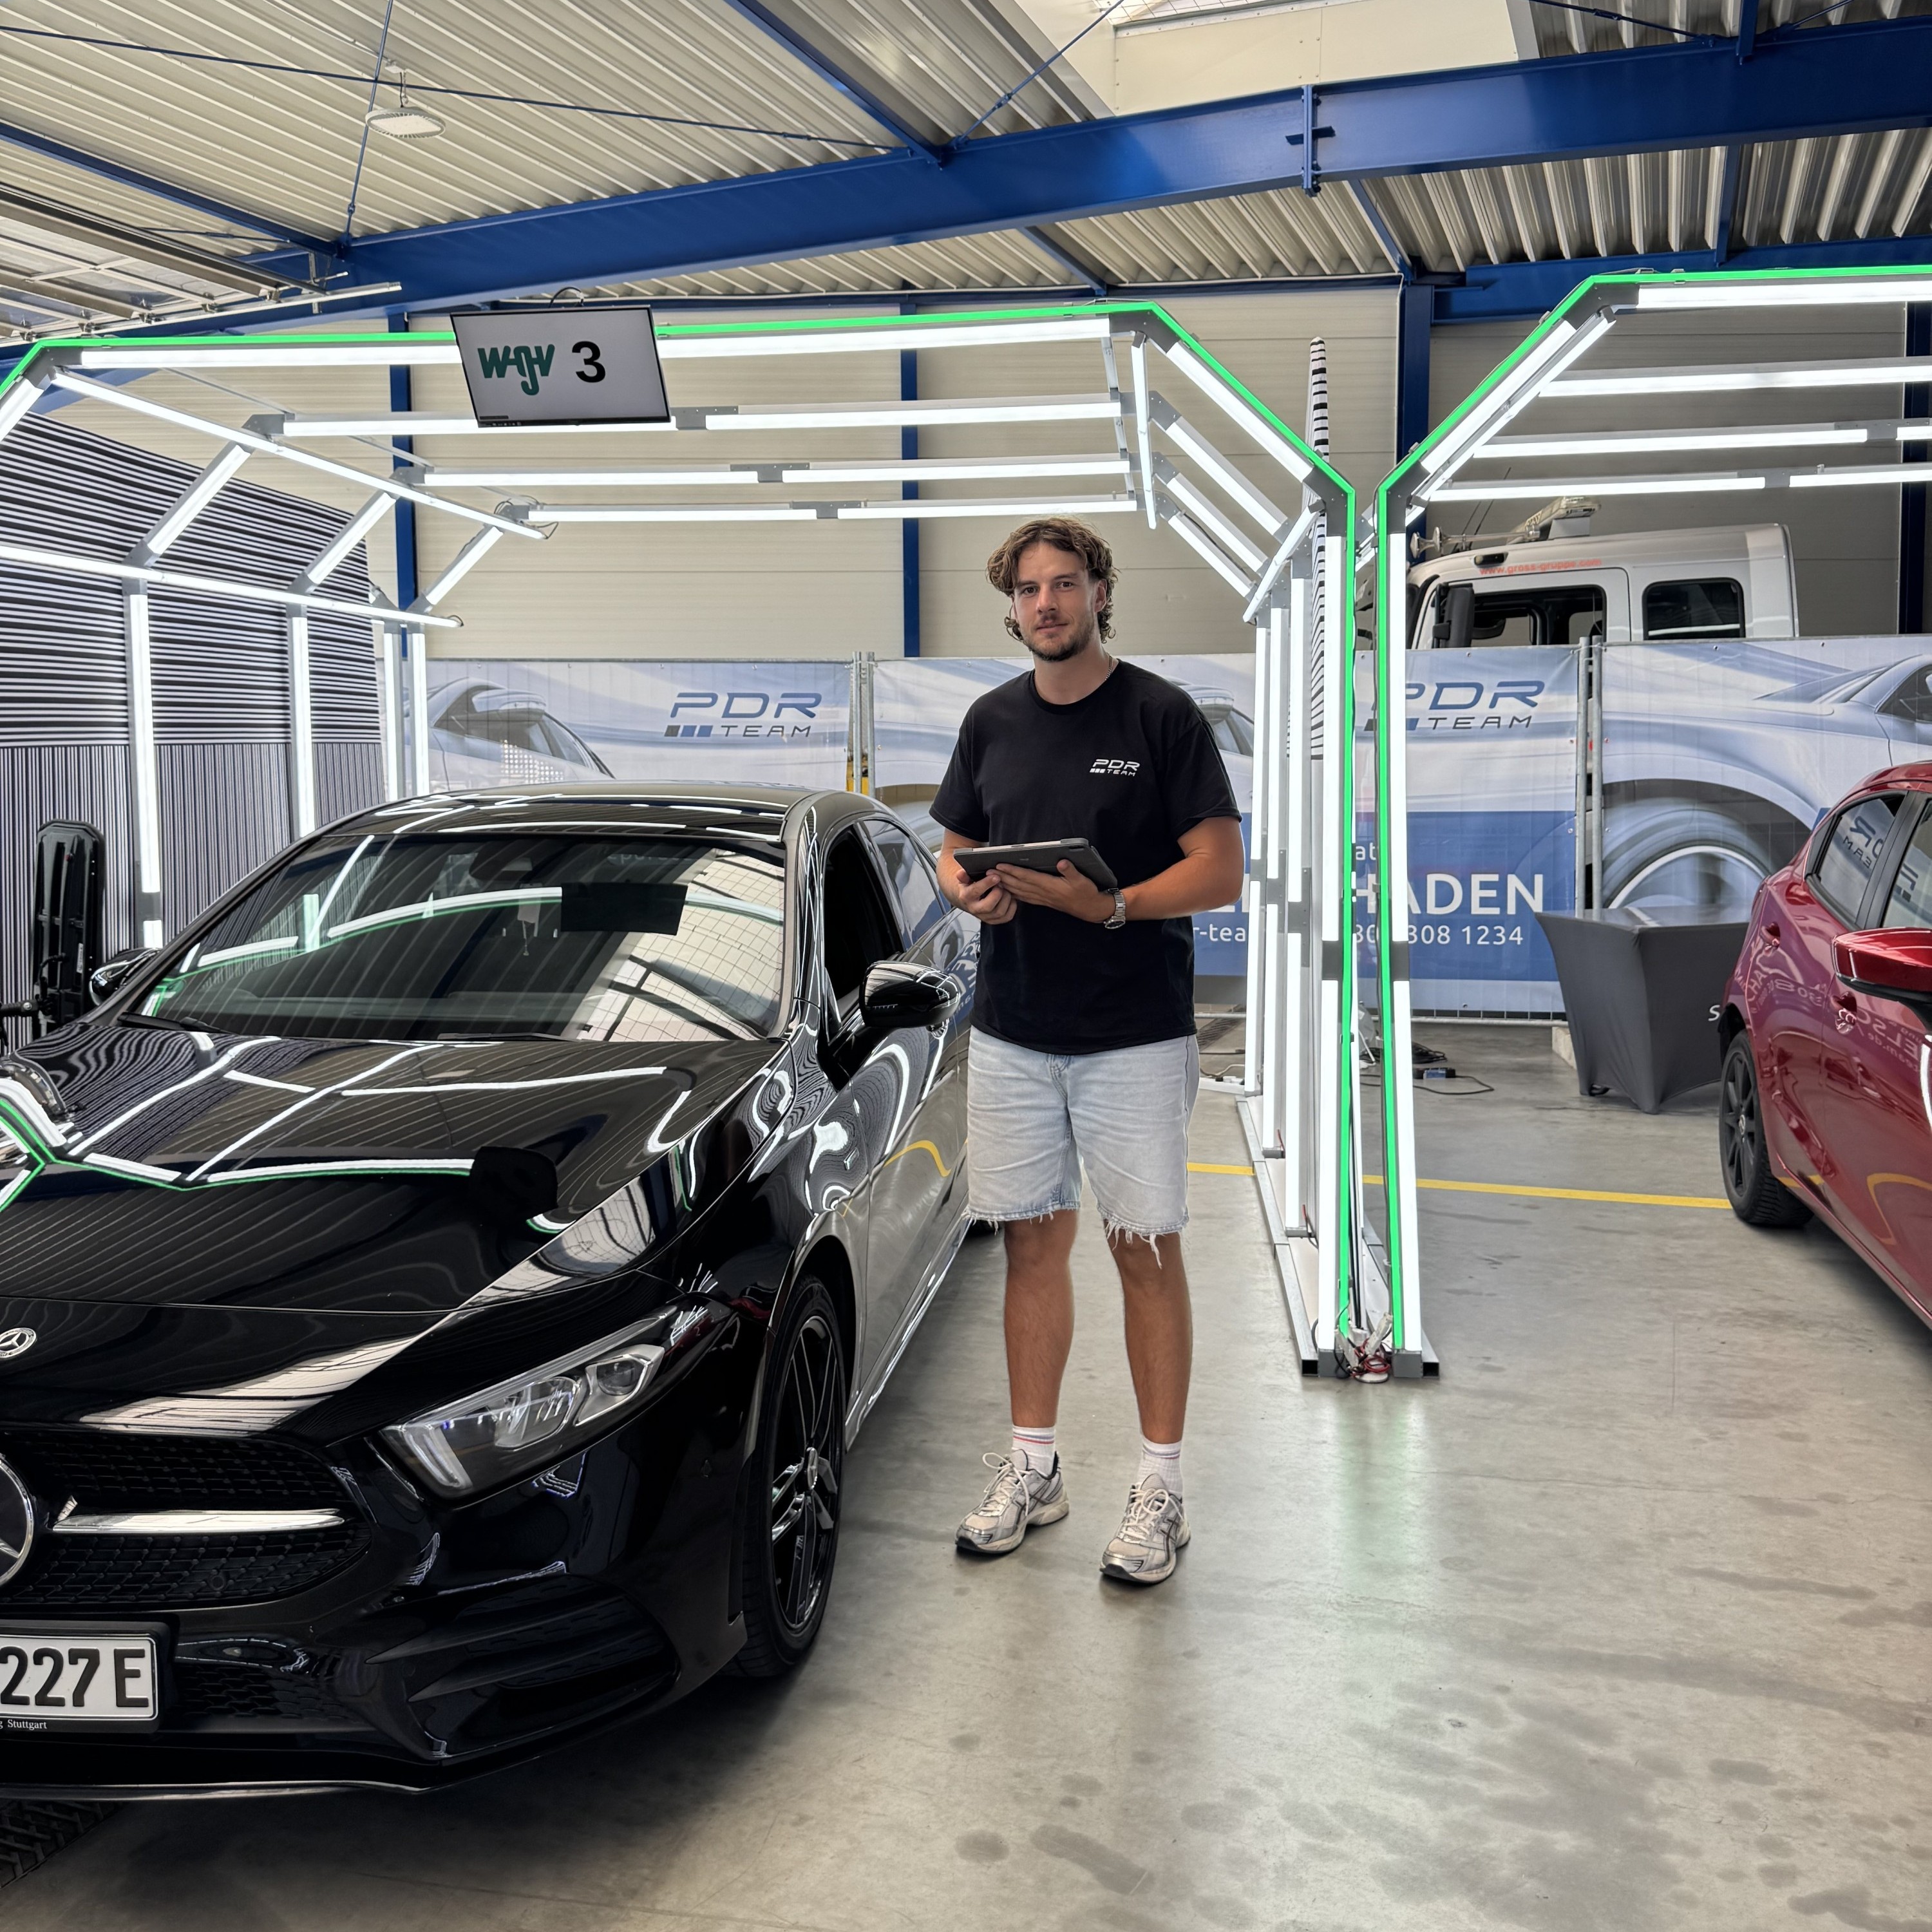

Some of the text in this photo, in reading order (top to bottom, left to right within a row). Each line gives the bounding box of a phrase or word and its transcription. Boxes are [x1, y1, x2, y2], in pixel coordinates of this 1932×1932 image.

[572, 341, 605, 383] 3
[670, 692, 822, 719] PDR
[1428, 715, 1532, 730] TEAM
[721, 725, 811, 737] TEAM
[1092, 759, 1140, 772] PDR
[1461, 926, 1524, 945] 1234
[8, 1719, 48, 1730] Stuttgart
